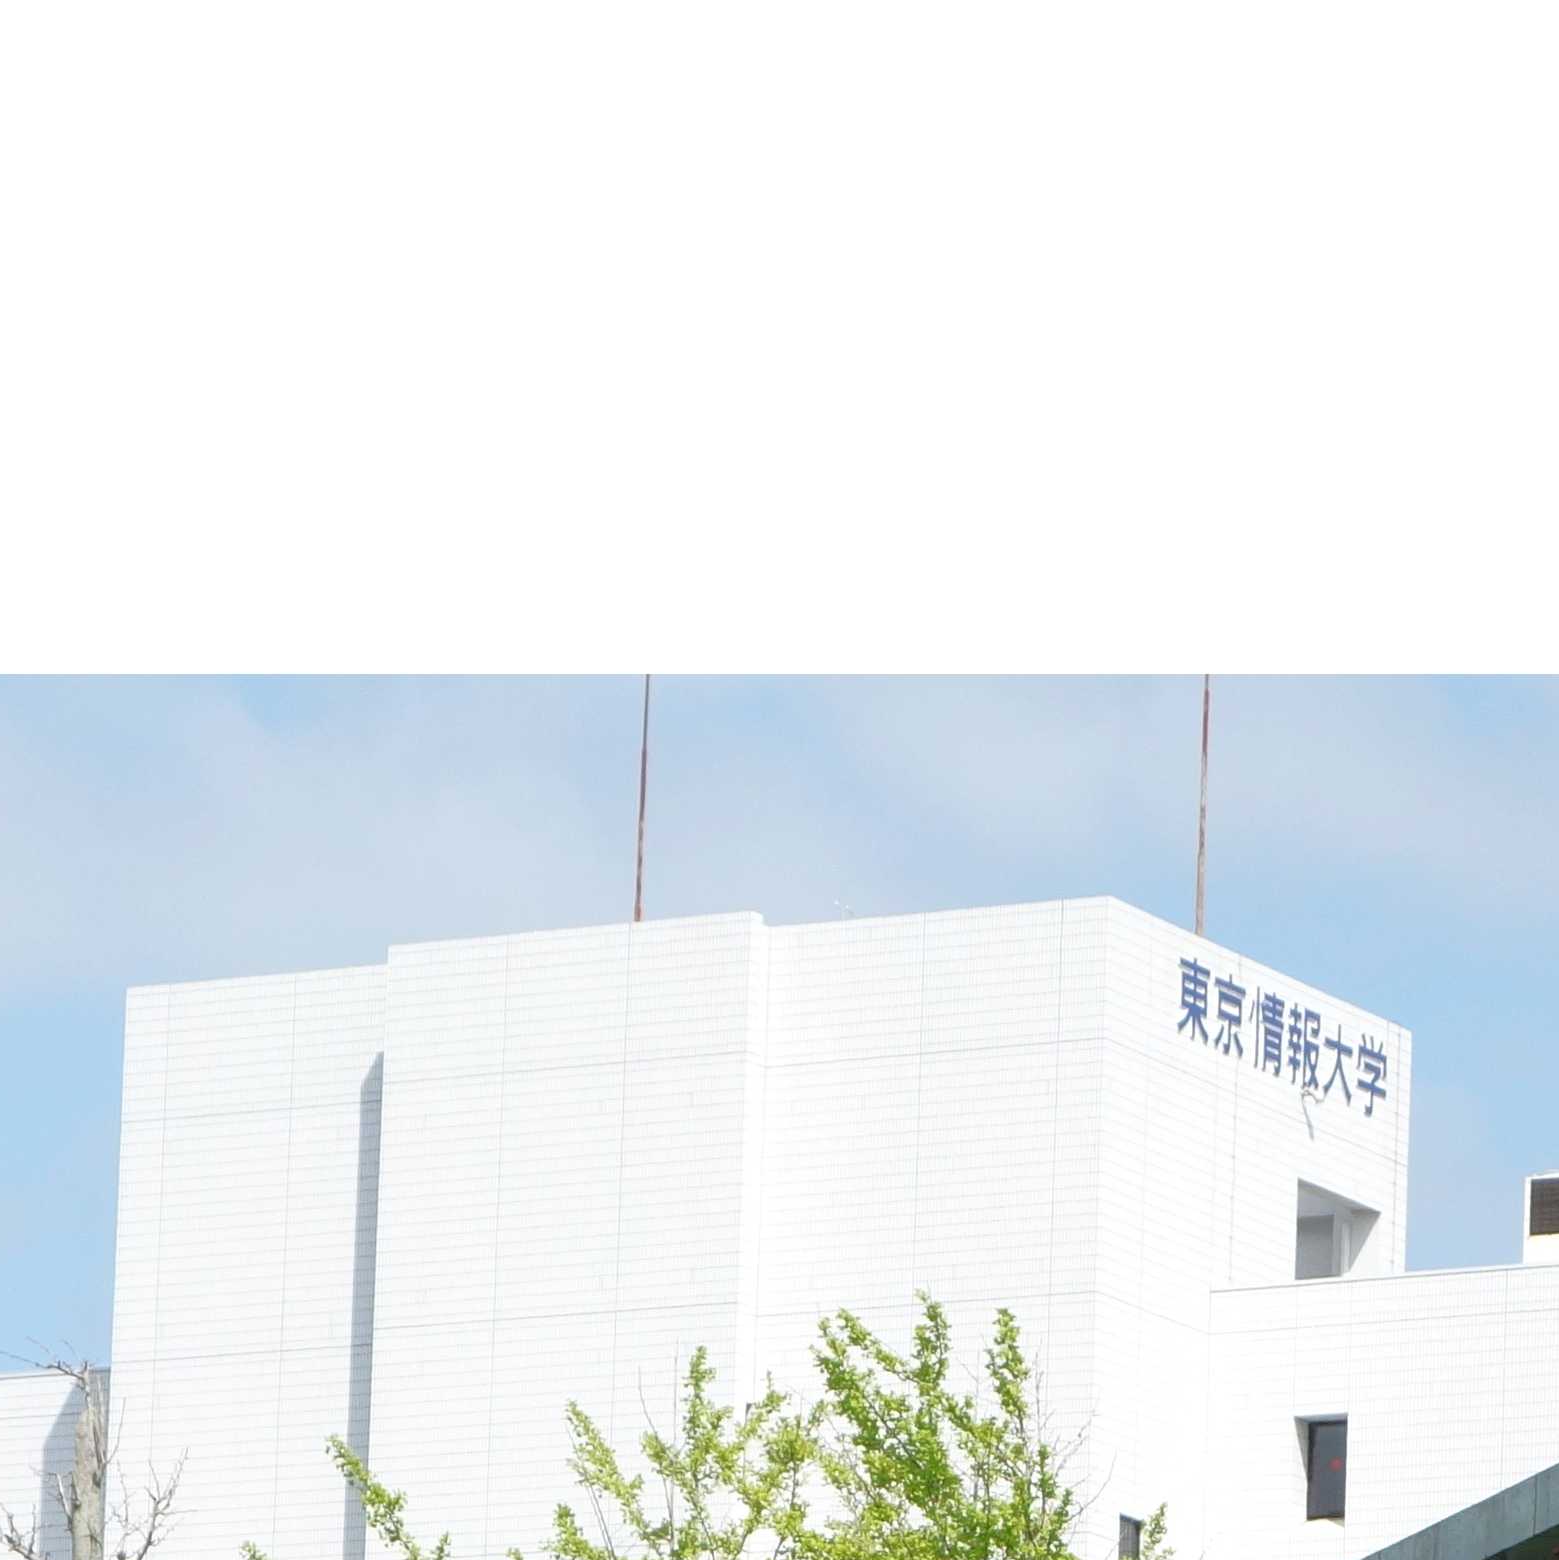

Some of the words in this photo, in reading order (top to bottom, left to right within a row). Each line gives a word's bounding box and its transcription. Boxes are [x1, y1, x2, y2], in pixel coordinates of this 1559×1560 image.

[1176, 956, 1388, 1118] 東京情報大学
